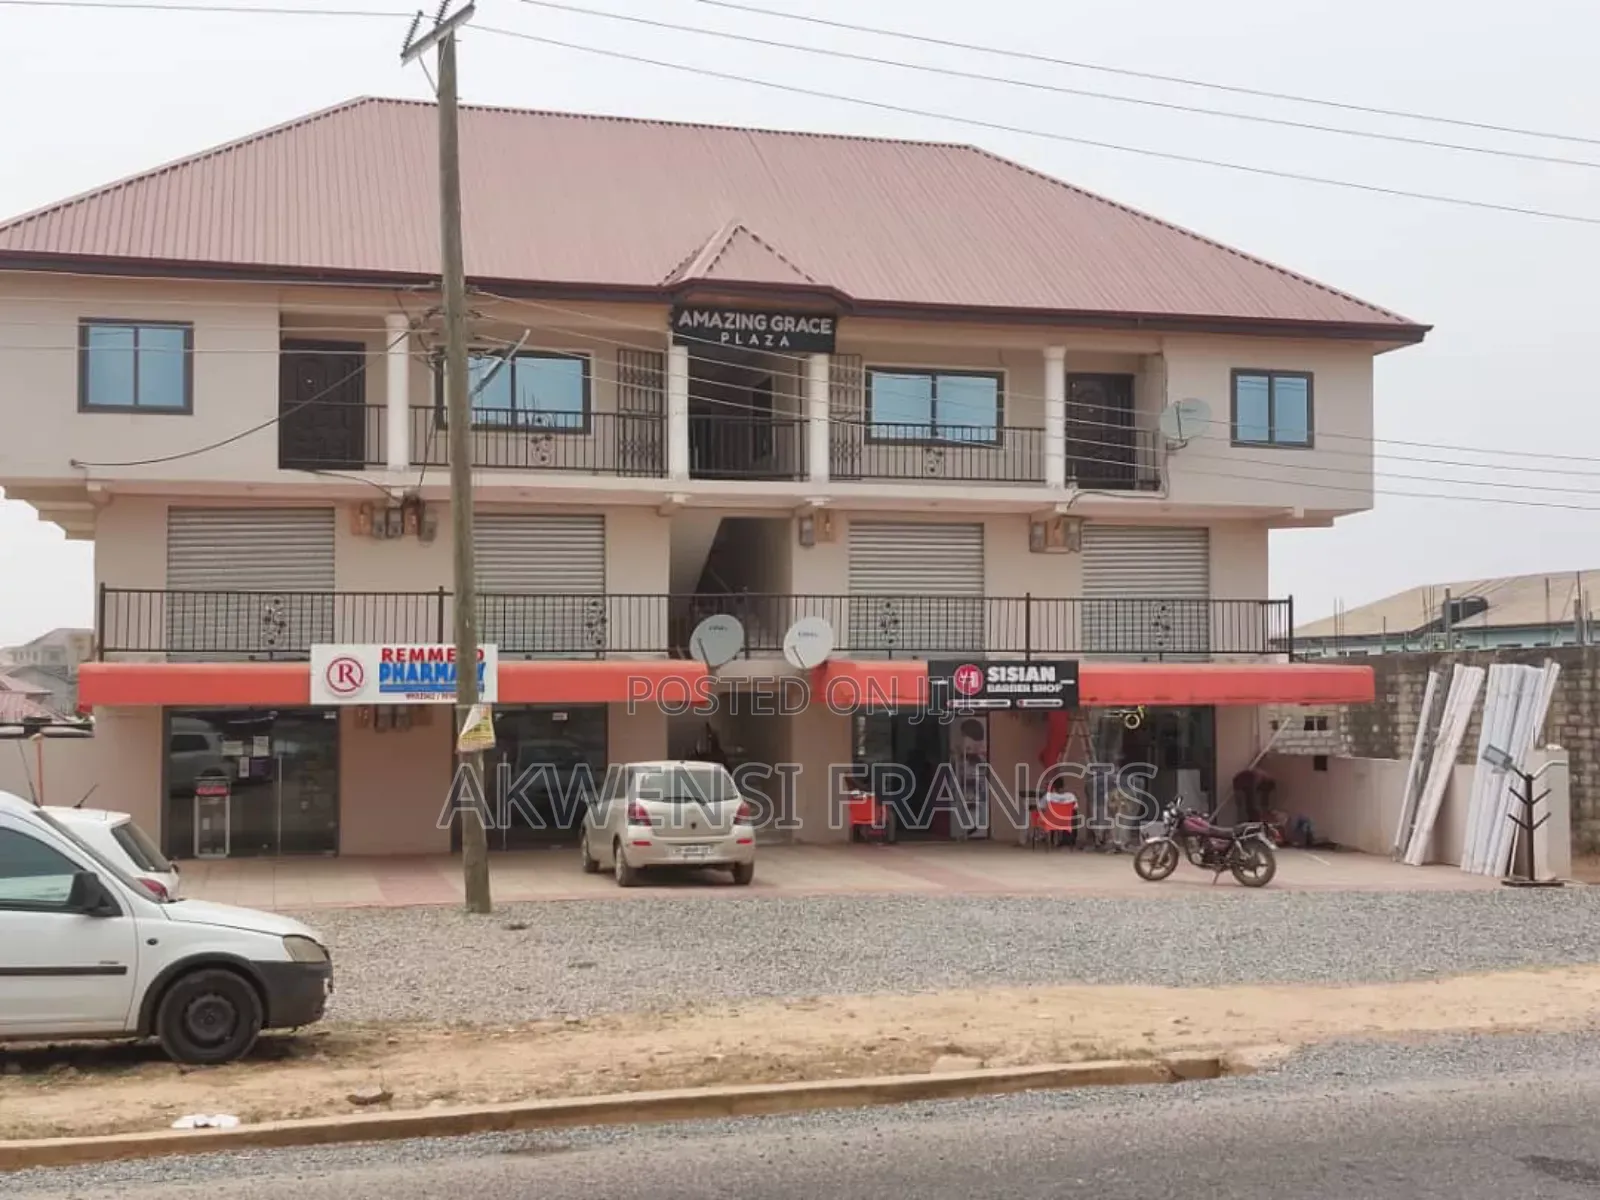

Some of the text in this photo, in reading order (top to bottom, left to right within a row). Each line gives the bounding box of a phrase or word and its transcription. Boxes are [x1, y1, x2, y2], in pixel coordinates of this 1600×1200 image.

[678, 311, 832, 334] AMAZING GRACE
[721, 333, 790, 346] PLAZA
[987, 666, 1056, 682] SISIAN
[1032, 683, 1063, 693] SHOP
